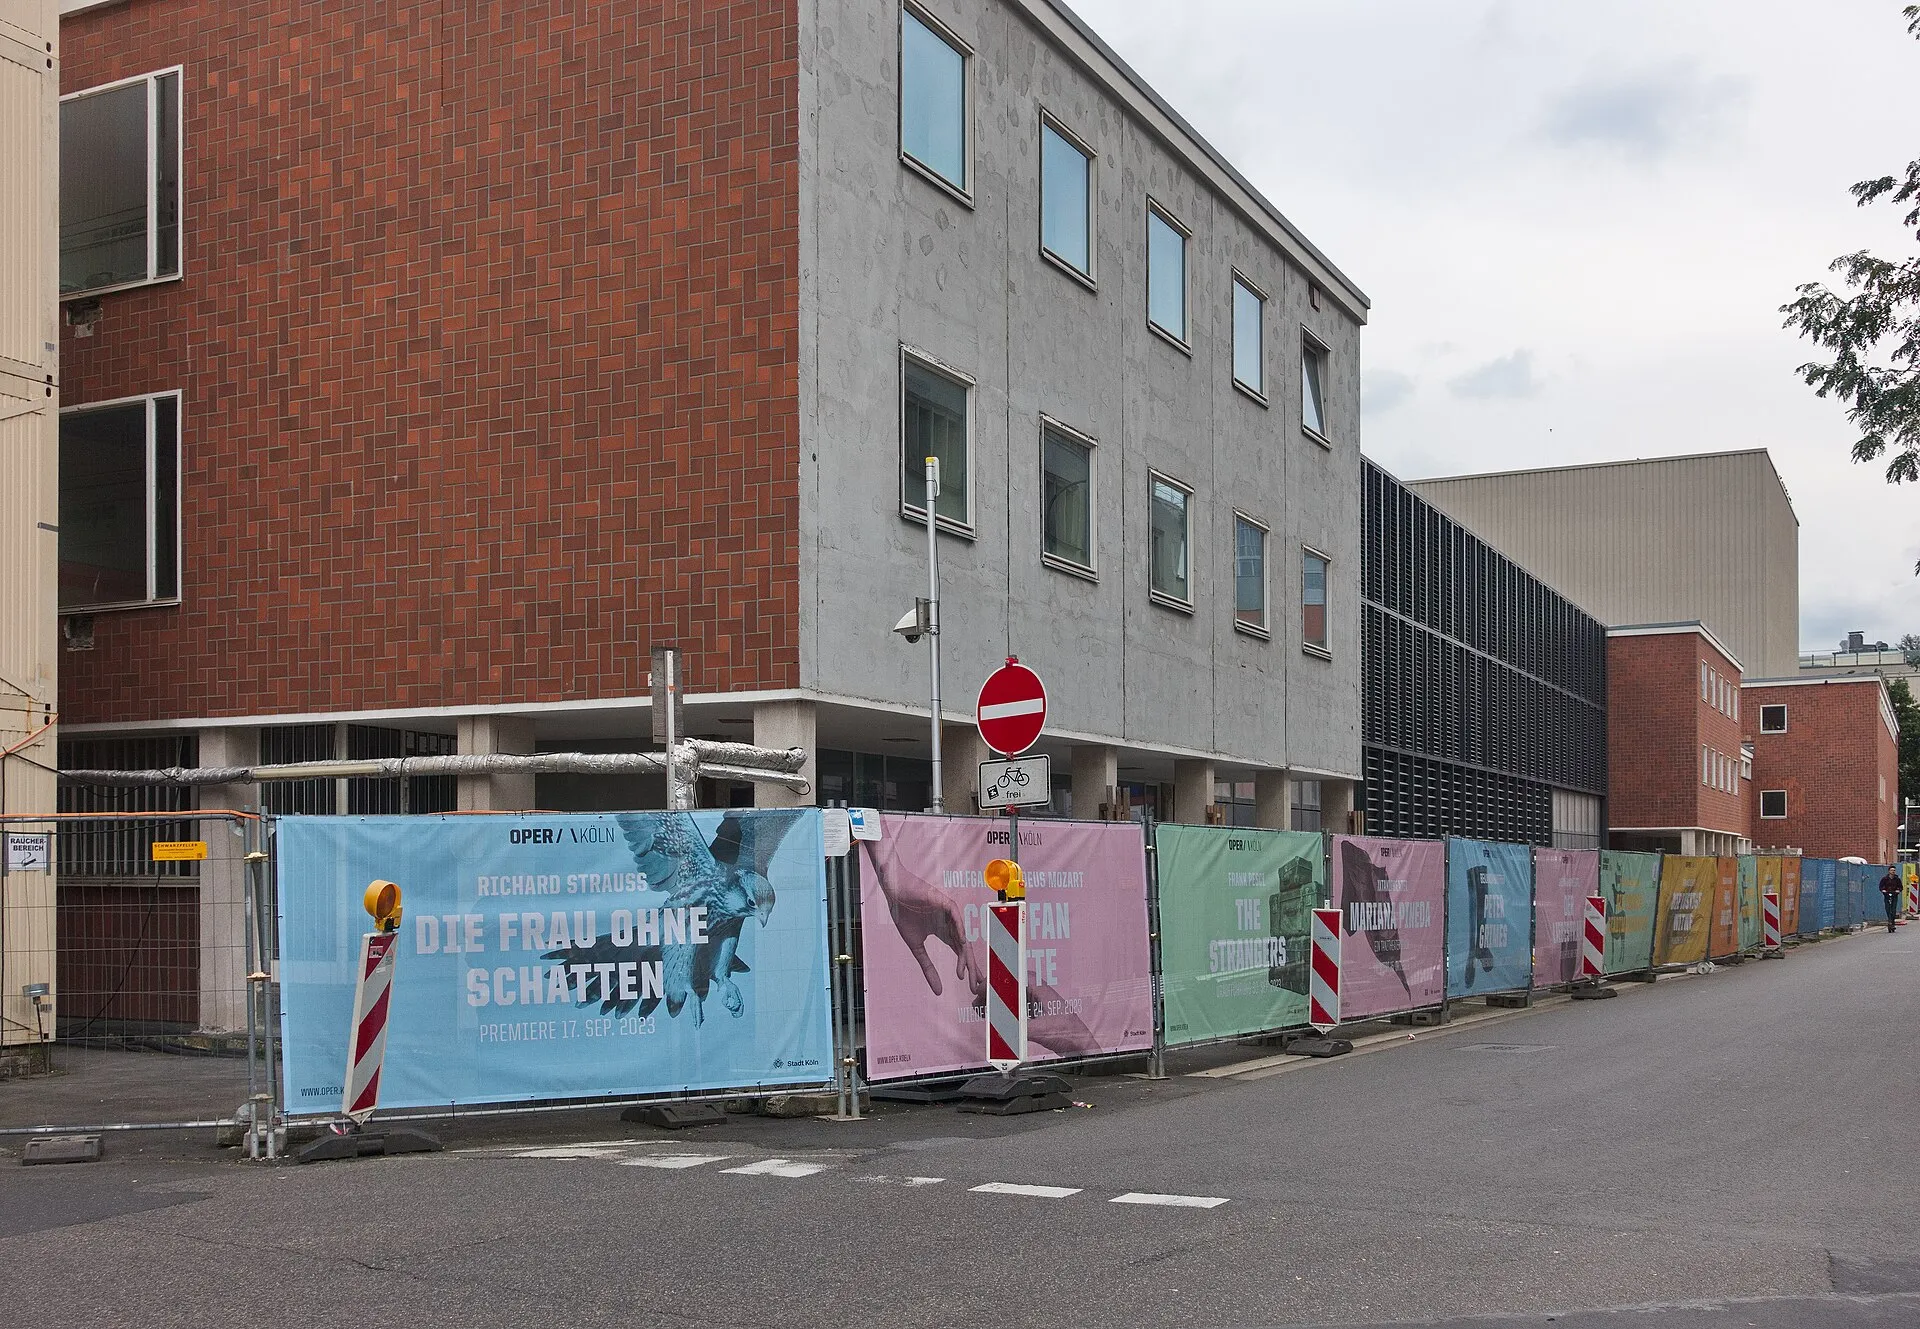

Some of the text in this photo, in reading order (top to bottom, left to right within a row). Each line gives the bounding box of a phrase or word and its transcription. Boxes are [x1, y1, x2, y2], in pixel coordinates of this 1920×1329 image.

[1006, 790, 1021, 799] frei
[10, 837, 47, 845] RAUCHER-
[986, 831, 1010, 845] OPER
[477, 872, 648, 897] RICHARD STRAUSS
[943, 870, 987, 888] WOLFGA
[1048, 871, 1084, 888] MOZART
[1235, 898, 1261, 930] THE
[1350, 902, 1397, 931] MARIANA
[1484, 894, 1504, 918] PETER
[416, 906, 709, 955] DIE FRAU OHNE
[1029, 902, 1071, 940] FAN
[1209, 935, 1287, 973] STRANGERS
[466, 960, 665, 1007] SCHATTEN
[1033, 1001, 1046, 1017] 24.
[1047, 1000, 1063, 1017] SEP.
[1064, 998, 1083, 1015] 2023
[479, 1016, 656, 1043] PREMIERE 17. SEP. 2023
[300, 1086, 345, 1097] WWW.OPER.K
